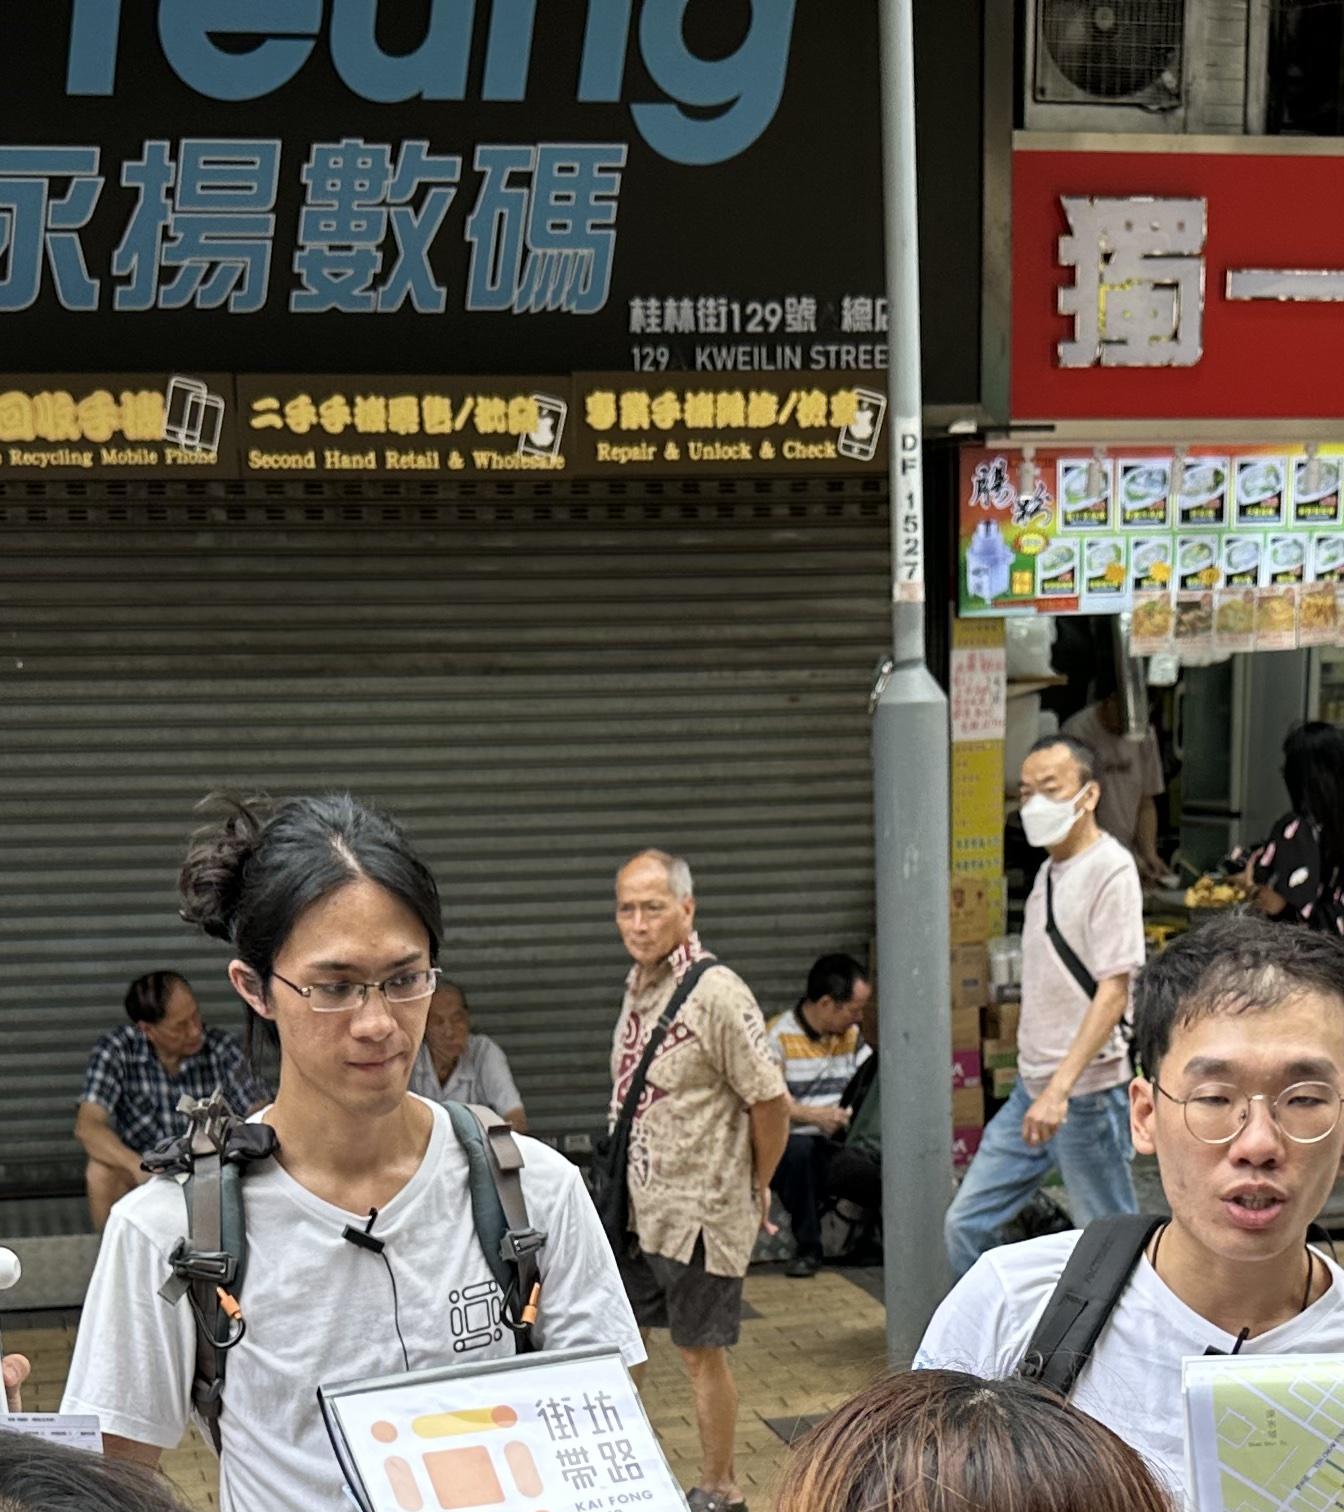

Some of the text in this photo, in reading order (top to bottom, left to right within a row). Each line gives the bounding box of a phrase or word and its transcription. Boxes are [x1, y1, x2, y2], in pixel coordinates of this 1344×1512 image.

[629, 297, 818, 336] 桂林街129號
[631, 347, 671, 372] 129
[695, 346, 803, 372] KWEILIN
[10, 450, 93, 468] Recycling
[101, 450, 158, 466] Mobile
[165, 449, 218, 466] Phone
[248, 450, 566, 470] Second Hand Retail & Wholesale
[596, 440, 838, 462] Repair & Unlock & Check
[535, 1390, 625, 1441] 街坊
[555, 1438, 645, 1490] 帶路
[574, 1490, 654, 1512] KAI FONG
